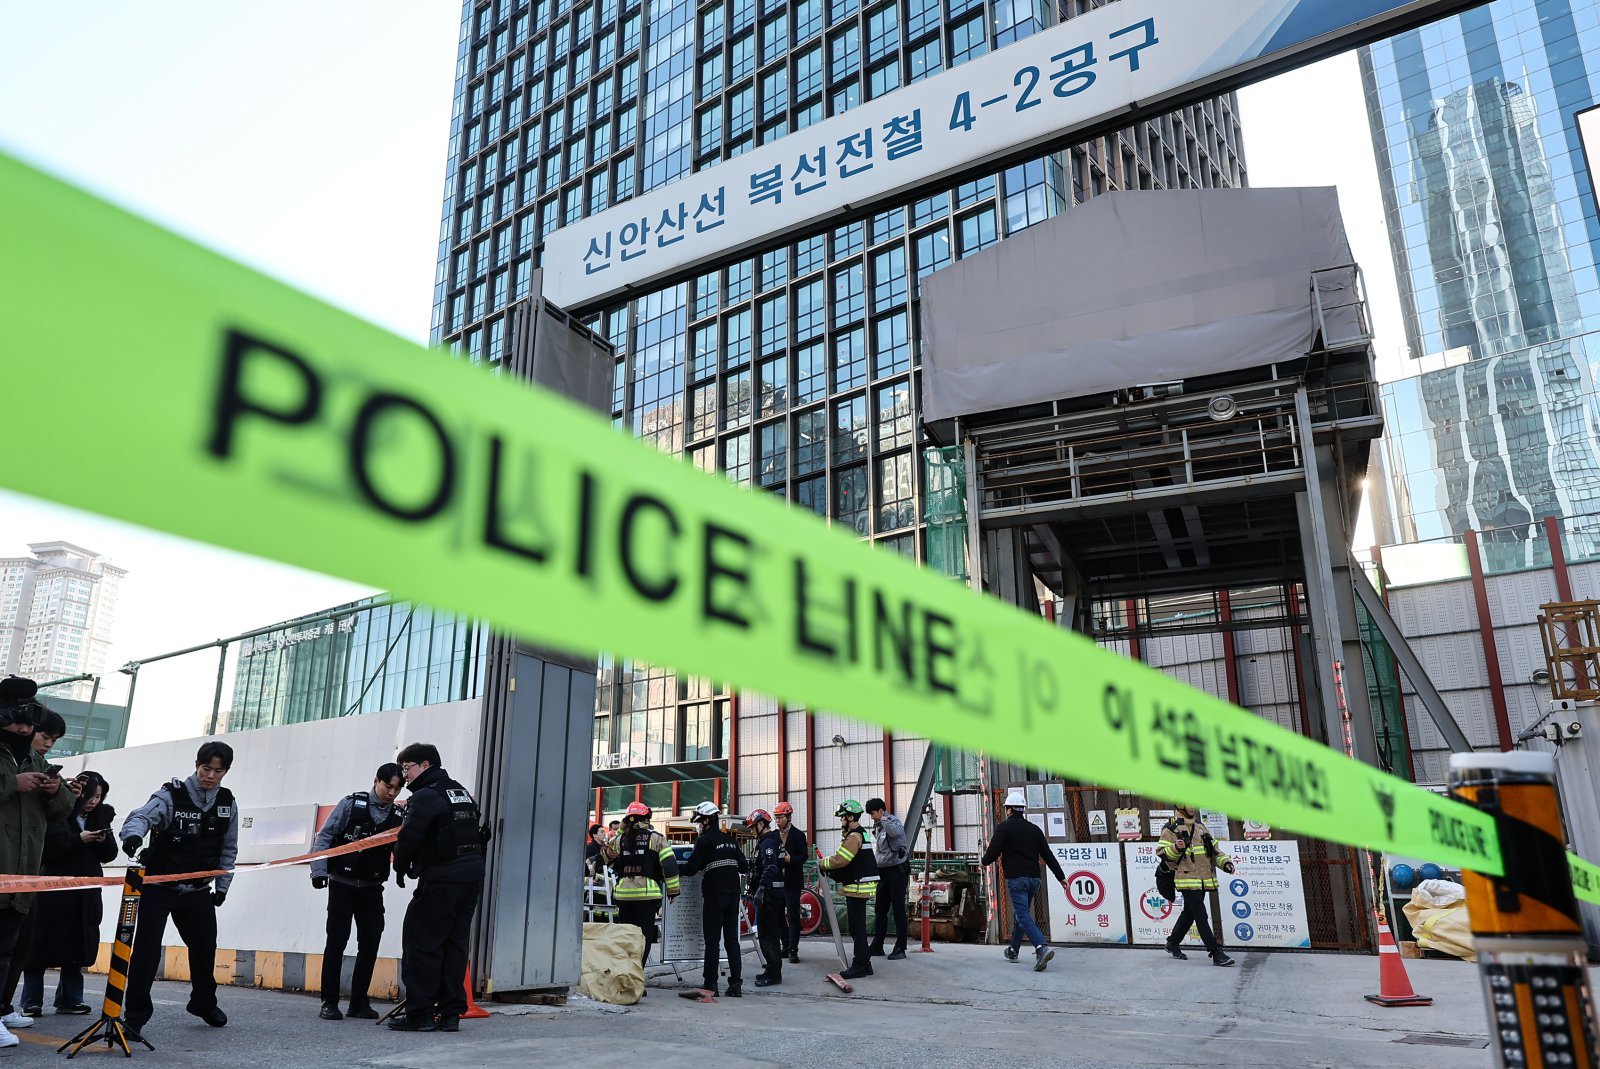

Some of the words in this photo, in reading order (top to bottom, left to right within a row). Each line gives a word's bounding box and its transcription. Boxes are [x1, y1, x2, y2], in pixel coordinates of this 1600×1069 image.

[582, 184, 726, 275] 신안산선
[748, 112, 924, 205] 복선전철
[949, 17, 1159, 130] 4-2공구
[203, 325, 753, 630] POLICE
[793, 553, 960, 698] LINE
[1103, 683, 1140, 761] 이
[1151, 700, 1210, 778] 선을
[593, 753, 628, 769] OWER
[175, 811, 202, 819] POLICE
[1138, 846, 1153, 854] 차량
[1234, 845, 1250, 853] 터널
[1252, 844, 1277, 853] 작업장
[1057, 848, 1092, 860] 작업장
[1096, 848, 1107, 860] 내
[1229, 855, 1247, 864] 수!!
[1250, 855, 1291, 864] 안전보호구
[1076, 880, 1095, 895] 10
[1251, 880, 1274, 888] 마스크
[1275, 880, 1291, 888] 착용
[1254, 902, 1277, 911] 안전모
[1278, 902, 1293, 911] 착용
[1065, 914, 1077, 927] 서
[1097, 914, 1109, 927] 행
[1138, 927, 1152, 935] 위반
[1153, 927, 1161, 935] 시
[1257, 924, 1280, 933] 귀마개
[1281, 924, 1296, 933] 착용
